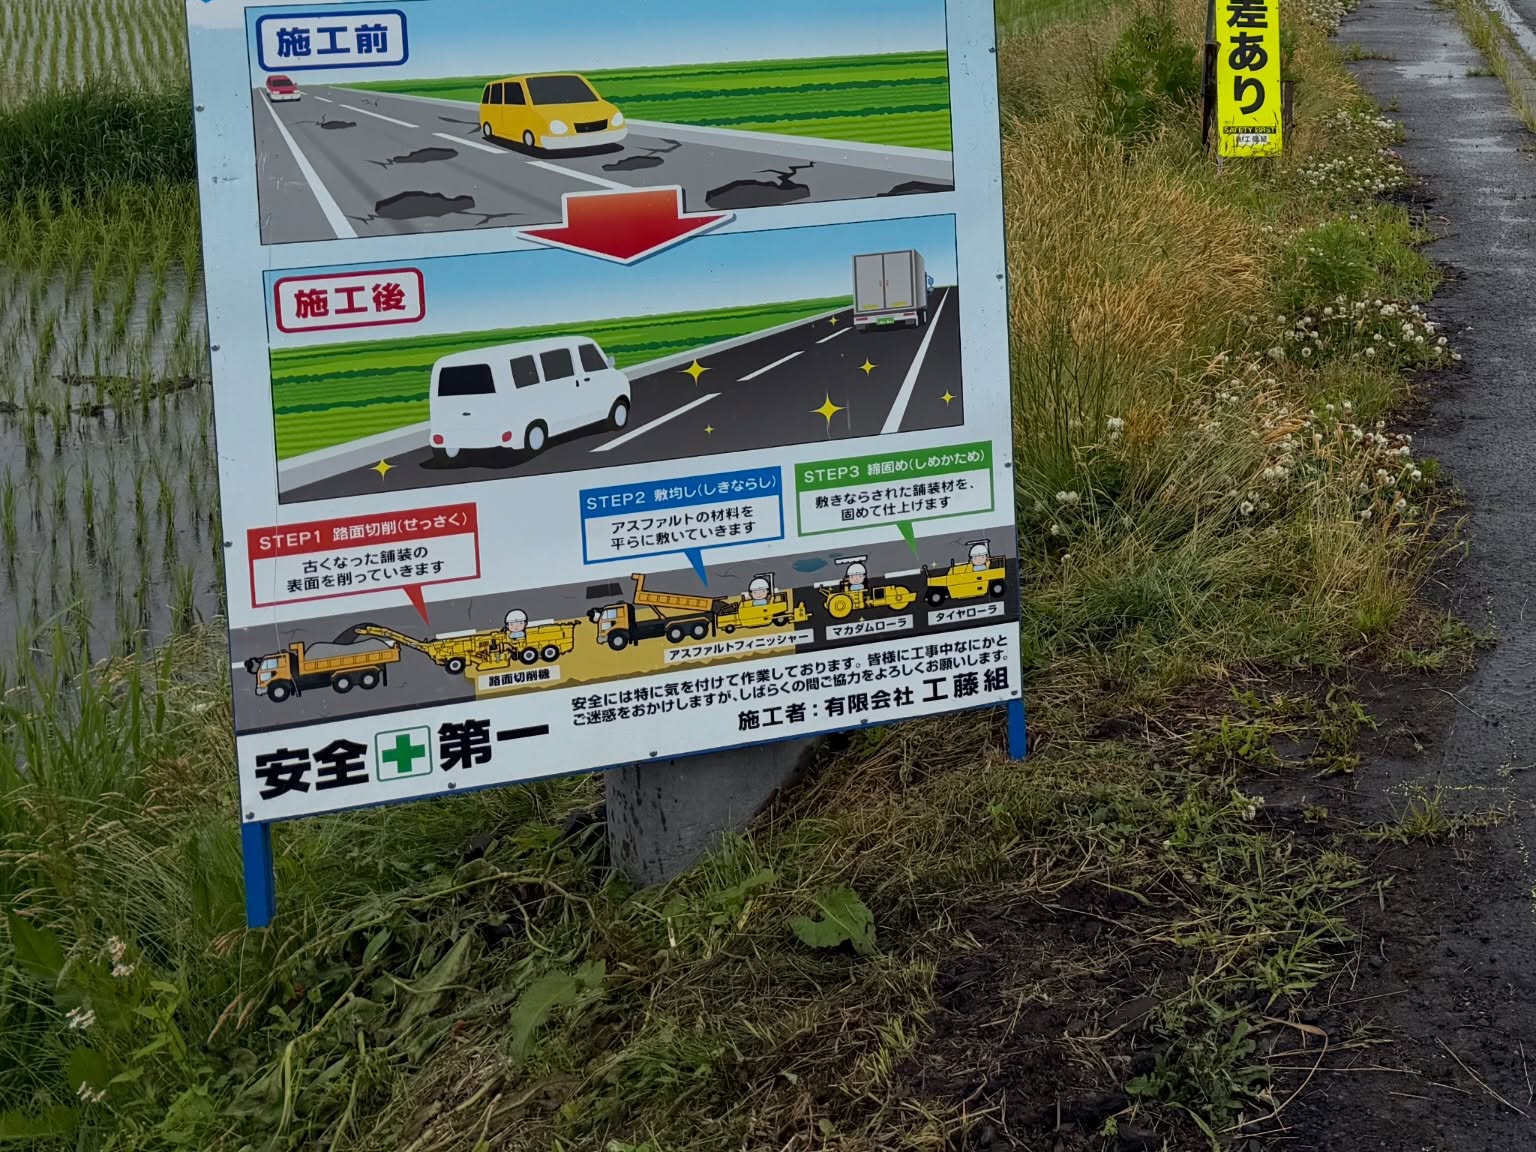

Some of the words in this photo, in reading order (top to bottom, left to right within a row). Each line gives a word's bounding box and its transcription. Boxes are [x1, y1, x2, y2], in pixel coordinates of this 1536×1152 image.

[276, 23, 389, 58] 施工前
[294, 282, 407, 319] 施工後
[804, 464, 860, 483] STEP3
[586, 491, 646, 511] STEP2
[841, 496, 952, 522] 固めて仕上げます
[611, 505, 754, 535] アスファルトの材料を
[259, 530, 322, 551] STEP1
[610, 520, 757, 551] 平らに敷いていきます
[302, 546, 429, 575] 古くなった舗装の
[286, 560, 446, 594] 表面を削っていきます
[832, 617, 908, 636] マカダムローラ
[935, 603, 998, 623] タイヤローラ
[669, 634, 809, 661] アスファルトフィニッシャー
[488, 668, 551, 688] 路面切削機
[922, 666, 1010, 703] 工藤組
